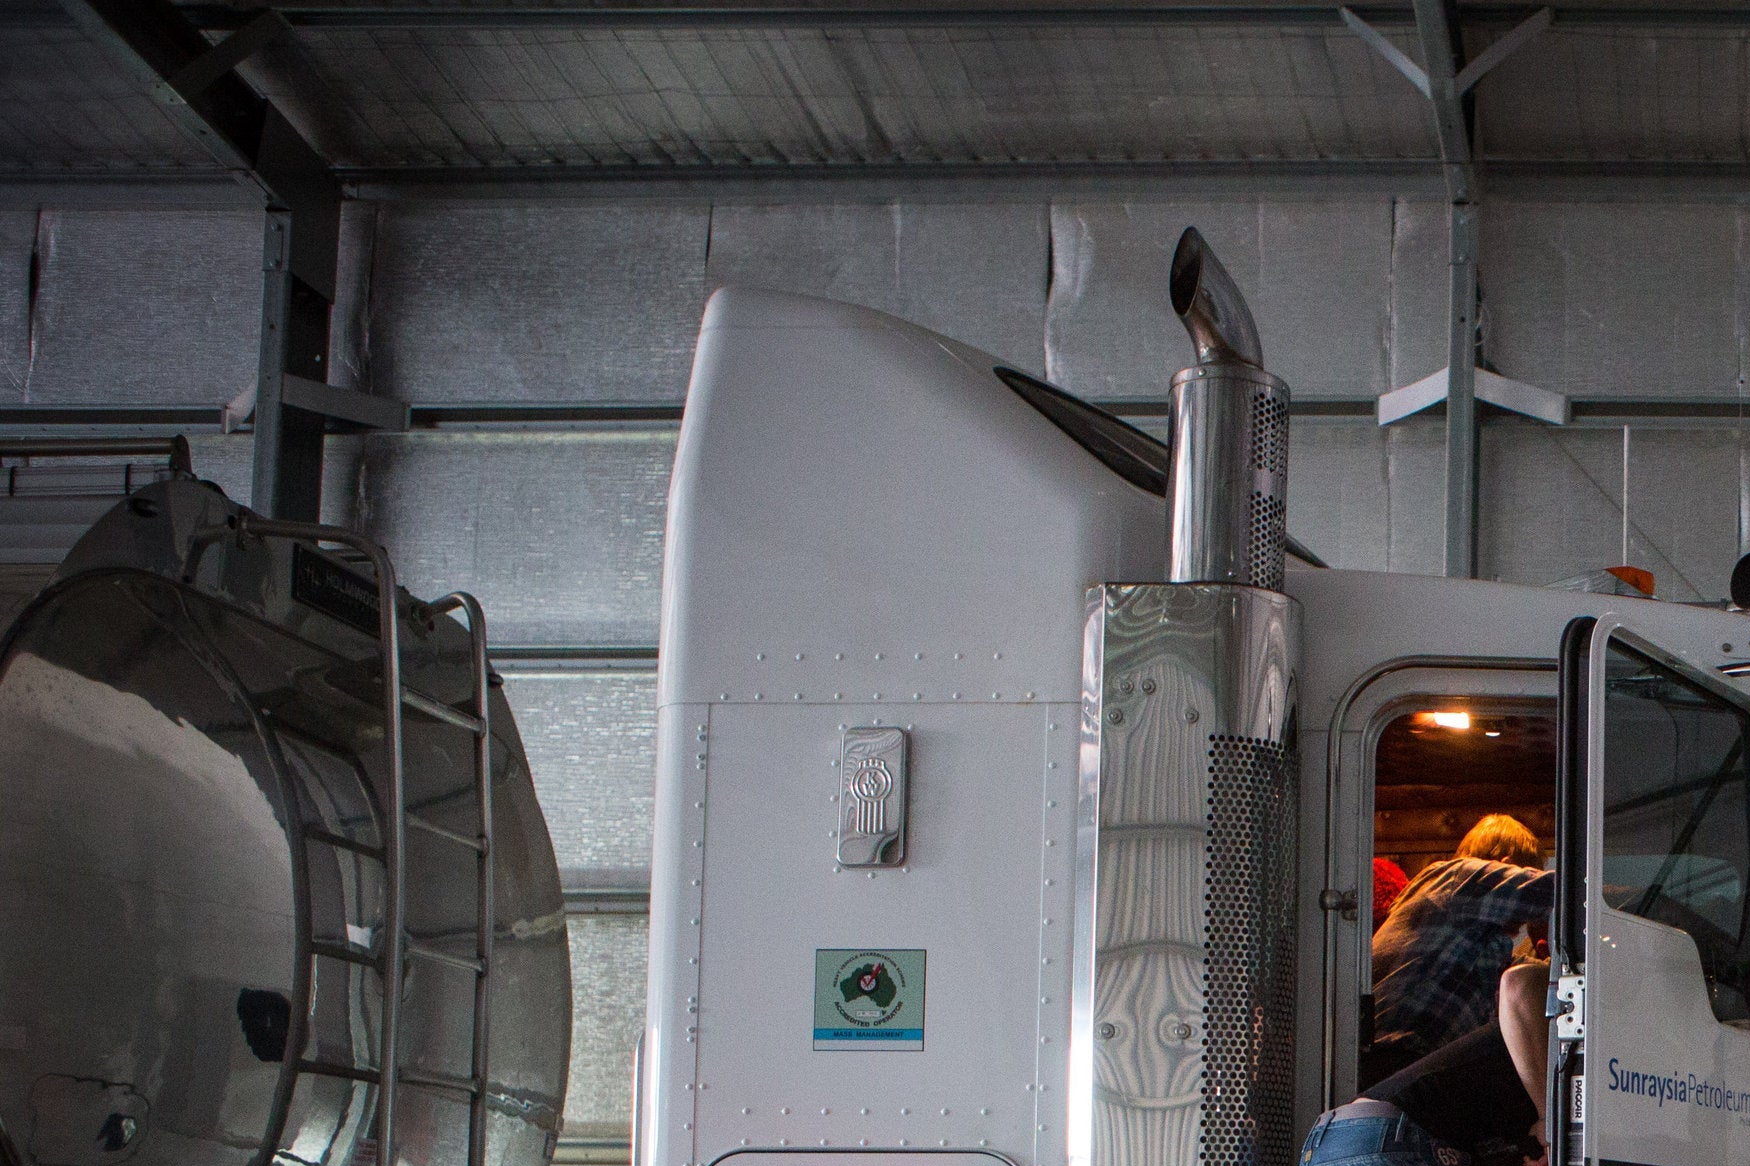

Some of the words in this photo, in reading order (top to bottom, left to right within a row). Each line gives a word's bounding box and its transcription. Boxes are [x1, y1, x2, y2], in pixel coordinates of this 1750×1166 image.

[834, 1001, 870, 1027] ACCREDITED
[873, 1001, 904, 1027] OPERATOR
[1574, 1080, 1583, 1119] PACCAR
